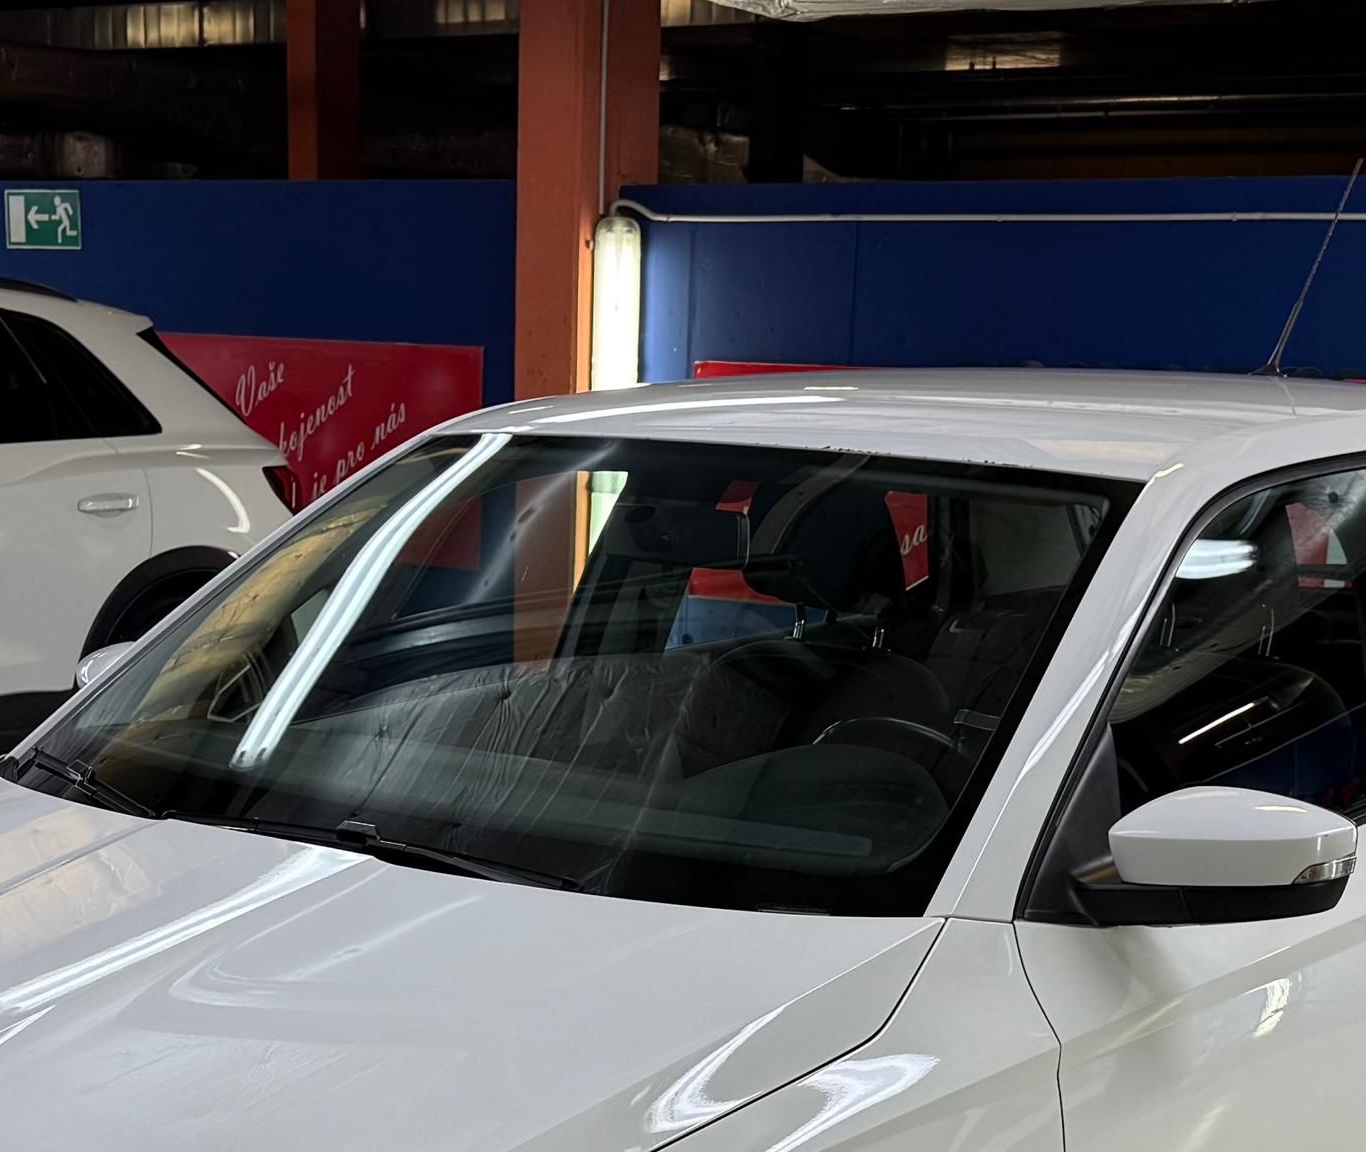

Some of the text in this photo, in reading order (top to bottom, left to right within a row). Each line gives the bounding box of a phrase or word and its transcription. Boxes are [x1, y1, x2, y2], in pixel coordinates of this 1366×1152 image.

[235, 361, 284, 416] Vaše
[336, 441, 364, 484] pro
[371, 402, 406, 450] nás
